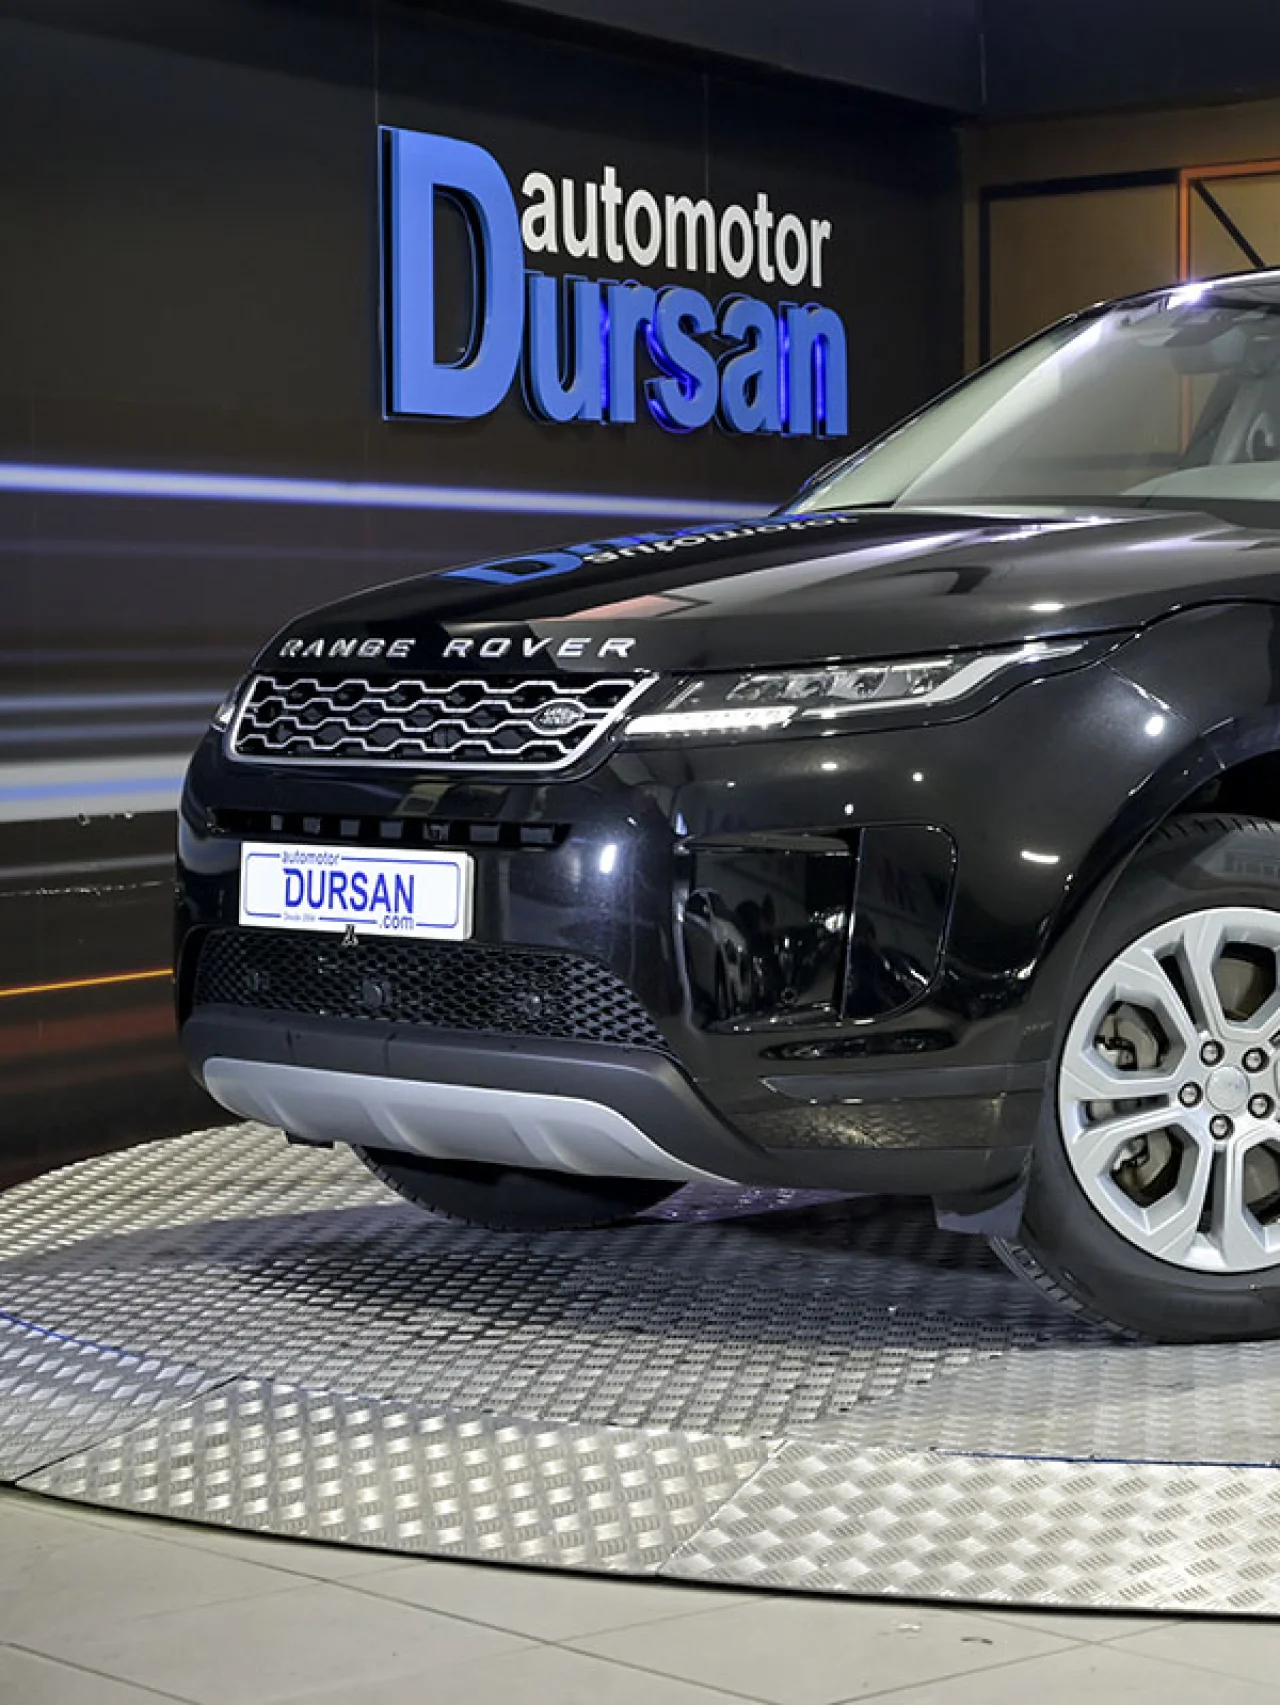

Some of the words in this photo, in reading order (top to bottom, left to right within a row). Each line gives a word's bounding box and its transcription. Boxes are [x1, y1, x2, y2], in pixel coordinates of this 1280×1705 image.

[521, 165, 832, 288] automotor
[377, 124, 849, 439] Dursan
[279, 637, 417, 659] RANGE
[442, 637, 637, 659] ROVER
[281, 850, 340, 866] automotor
[283, 867, 415, 914] DURSAN
[379, 914, 415, 930] .com
